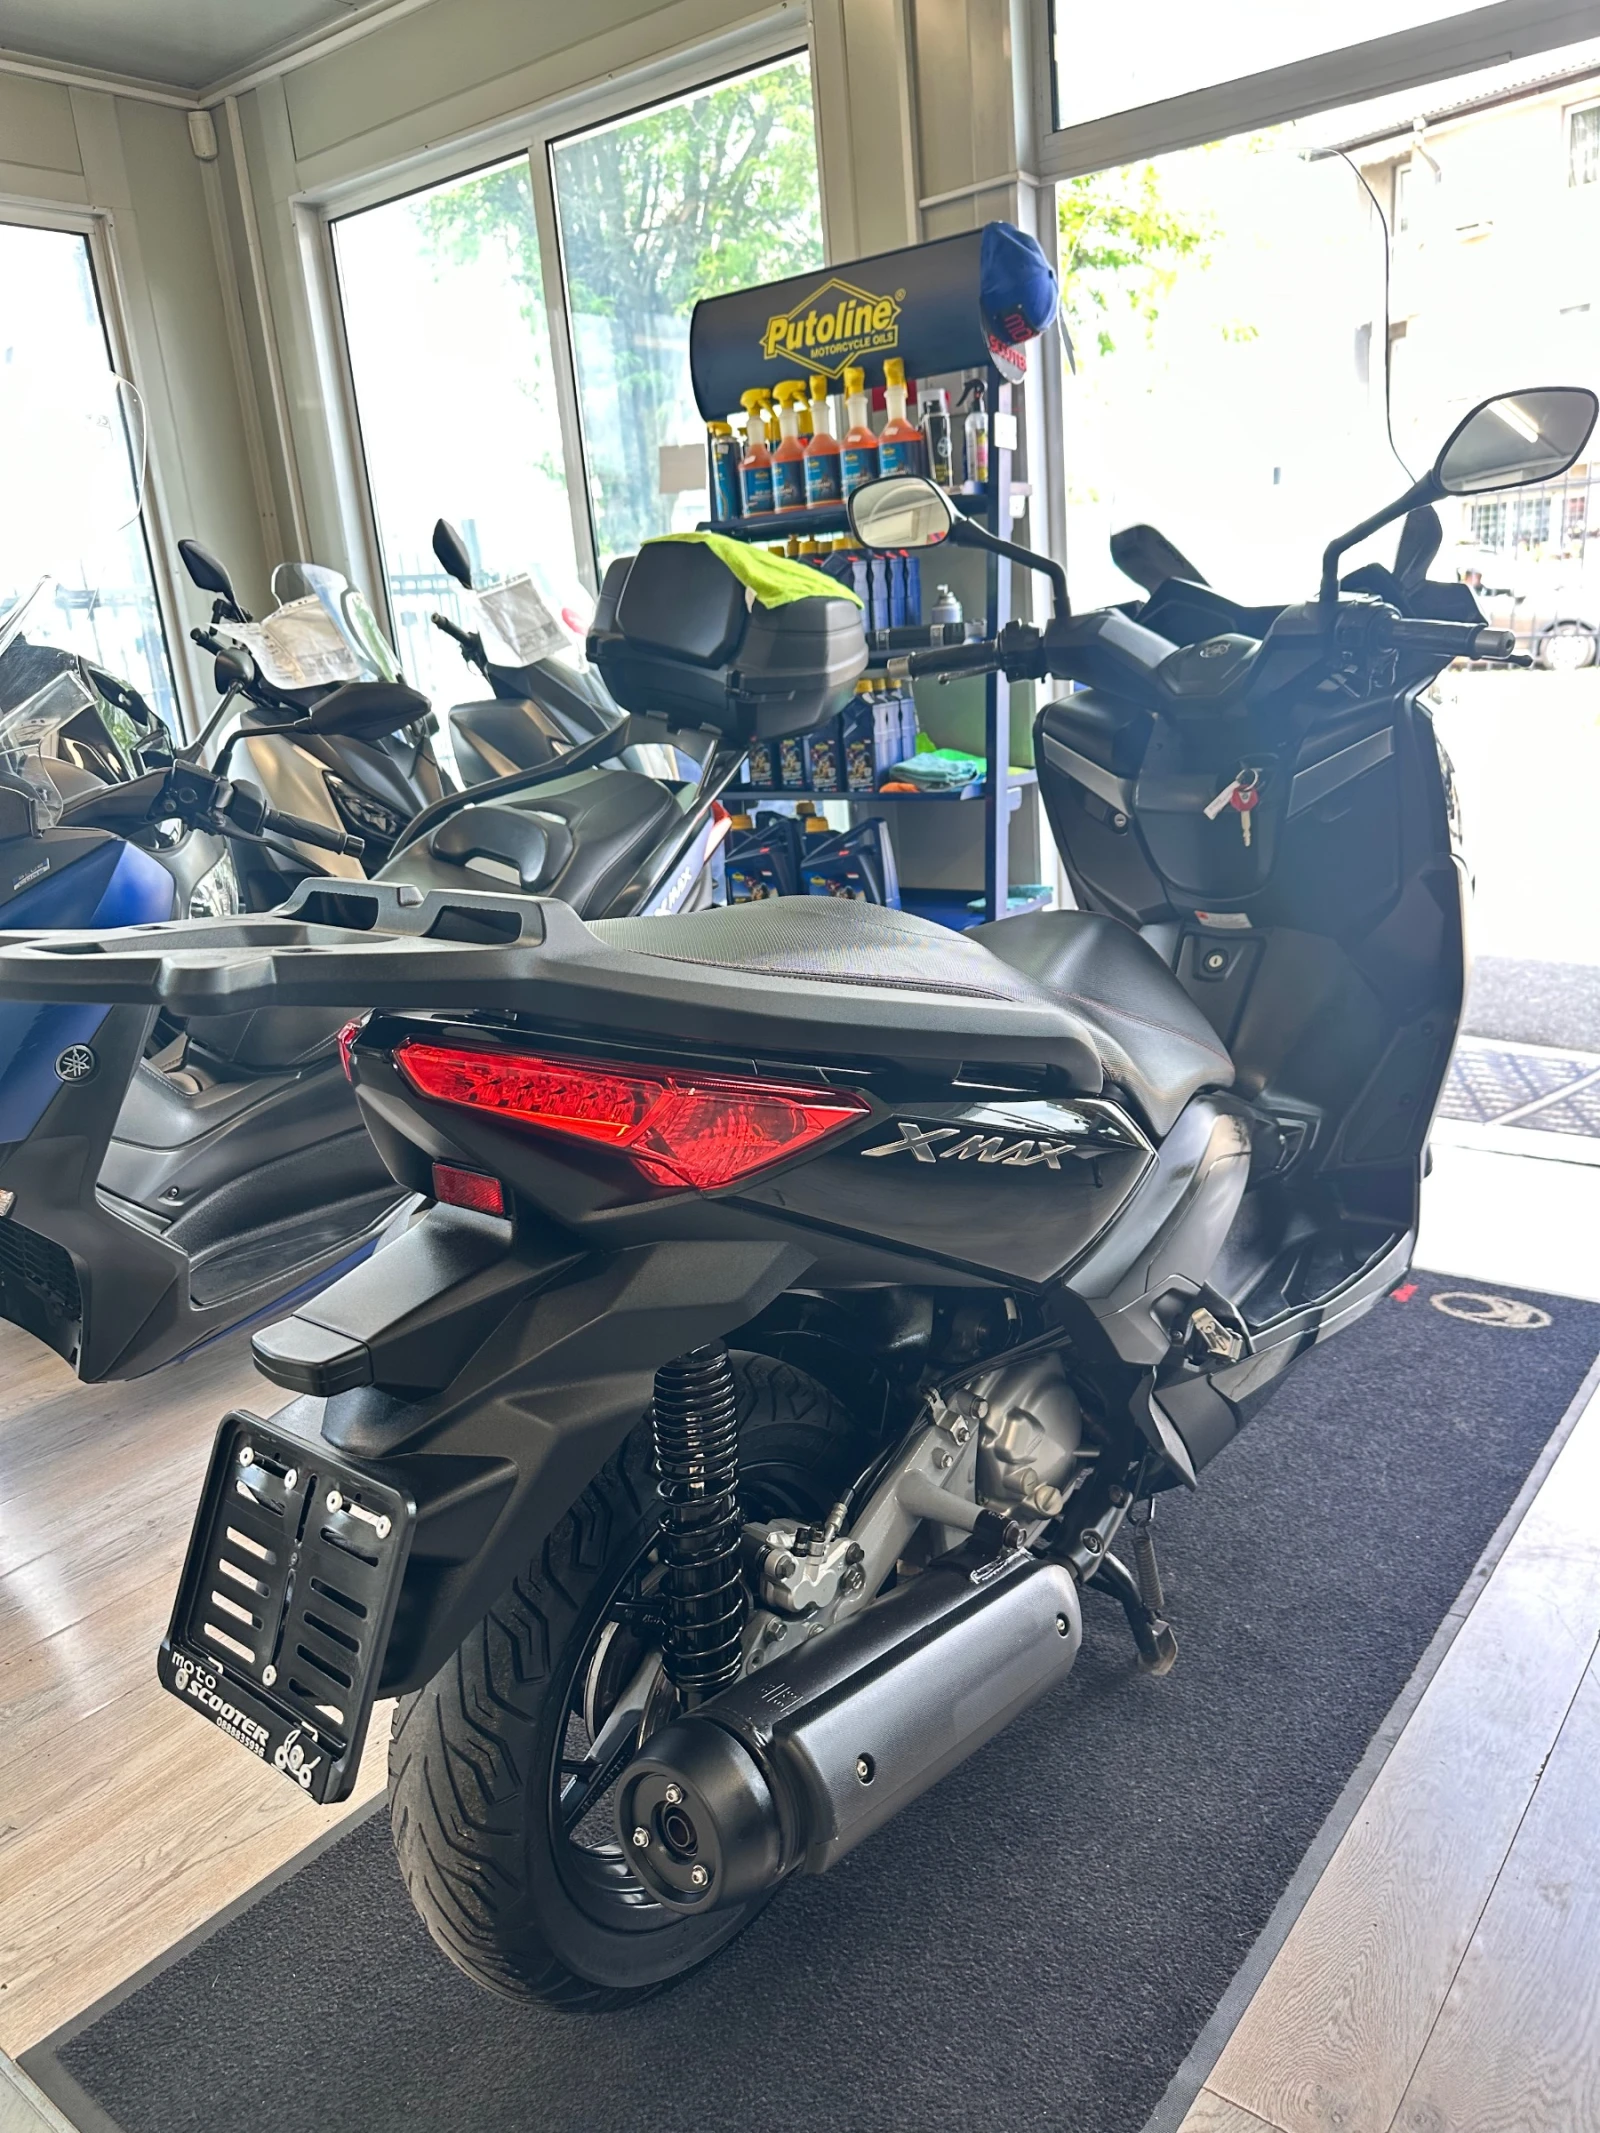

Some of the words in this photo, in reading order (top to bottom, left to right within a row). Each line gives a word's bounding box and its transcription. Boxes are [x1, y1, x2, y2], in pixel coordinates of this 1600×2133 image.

[767, 299, 892, 355] Putoline
[810, 337, 871, 358] MOTORCYCLE
[872, 332, 894, 345] OILS
[187, 1680, 270, 1747] SCOOTER
[216, 1716, 266, 1758] 0888835936
